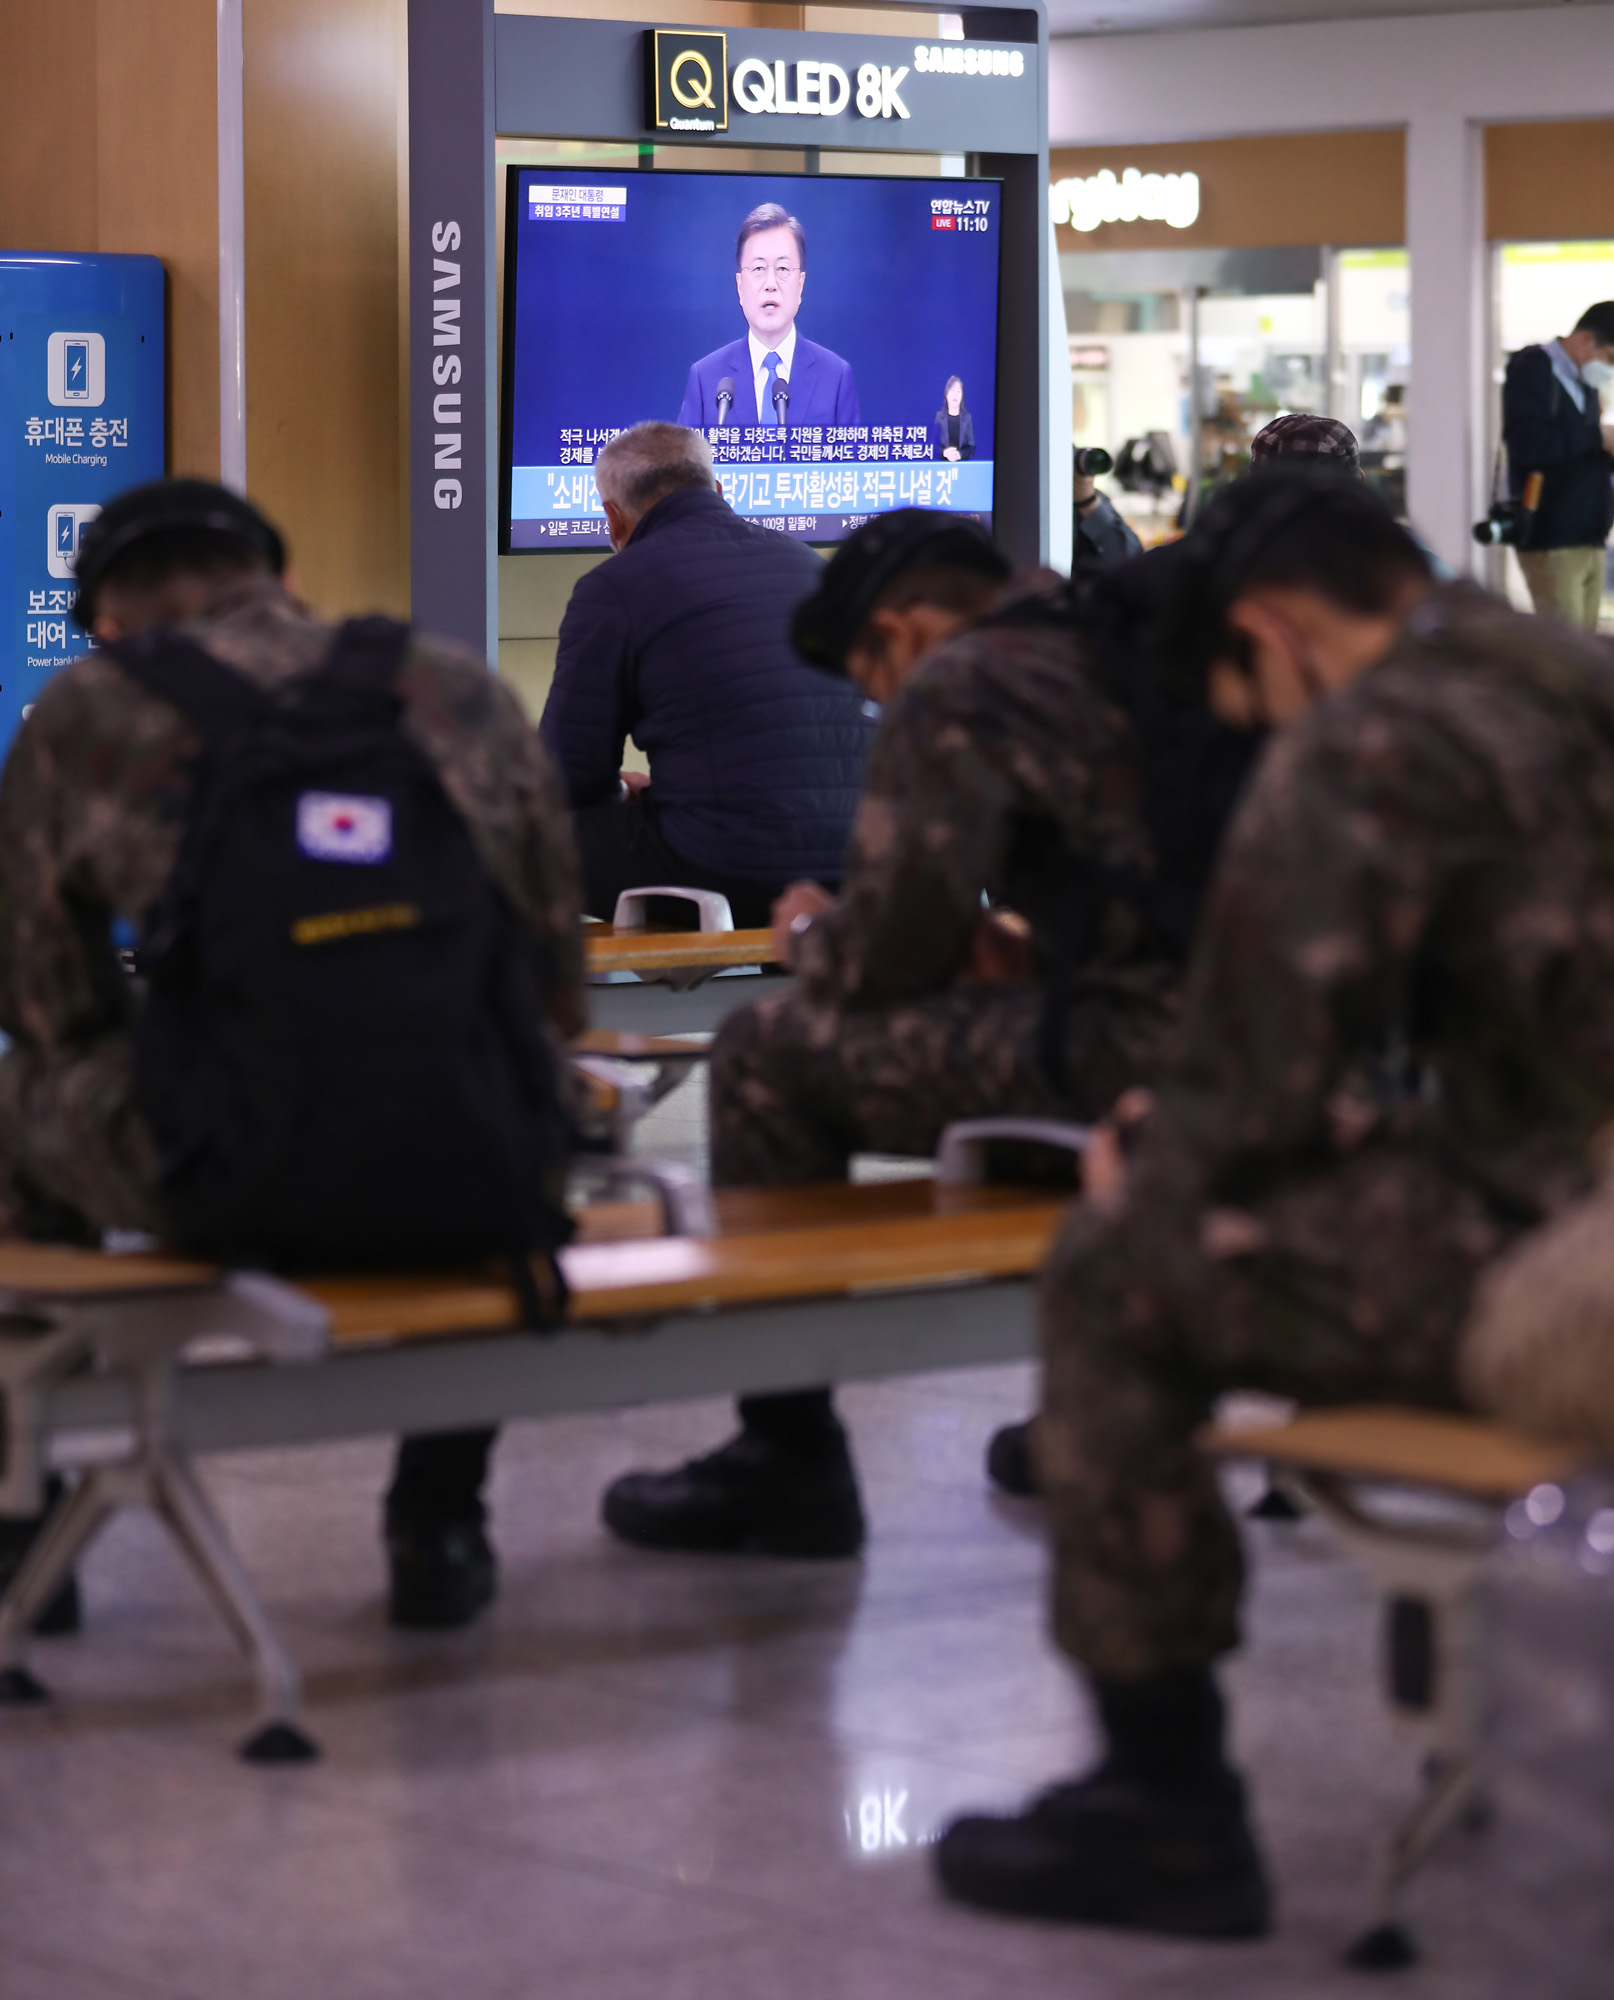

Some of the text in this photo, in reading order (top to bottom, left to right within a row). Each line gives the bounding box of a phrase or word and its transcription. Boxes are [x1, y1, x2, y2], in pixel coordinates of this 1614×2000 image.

[914, 45, 1024, 77] SAMSUNG
[670, 49, 716, 109] Q
[732, 58, 911, 120] QLED 8K
[669, 117, 715, 131] Quantum
[551, 188, 604, 202] 문재인 대통령
[534, 204, 620, 219] 취임 3주년 특별연설
[930, 199, 990, 215] 연합뉴스TV
[935, 216, 988, 232] LIVE 11:10
[431, 221, 463, 510] SAMSUNG
[24, 417, 128, 448] 휴대폰 충전
[559, 428, 583, 445] 적극
[708, 427, 741, 444] 활력을
[744, 427, 788, 444] 되찾도록
[790, 427, 823, 444] 지원을
[826, 427, 869, 443] 강화하며
[871, 426, 903, 443] 위축된
[905, 426, 928, 442] 지역
[45, 453, 108, 467] Mobile Charging
[559, 447, 594, 464] 경제를
[789, 445, 854, 461] 국민들께서도
[857, 444, 889, 461] 경제의
[891, 444, 934, 460] 주체로서
[774, 470, 859, 509] 투자활성화
[862, 470, 896, 507] 적극
[900, 469, 932, 506] 나설
[935, 467, 958, 506] 것"
[548, 521, 569, 536] 일본
[570, 520, 602, 536] 코로나
[762, 517, 785, 532] 100명
[787, 516, 817, 531] 밑돌아
[849, 515, 868, 530] 정부
[27, 621, 66, 649] 대여
[27, 657, 51, 667] Power
[53, 656, 73, 667] bank
